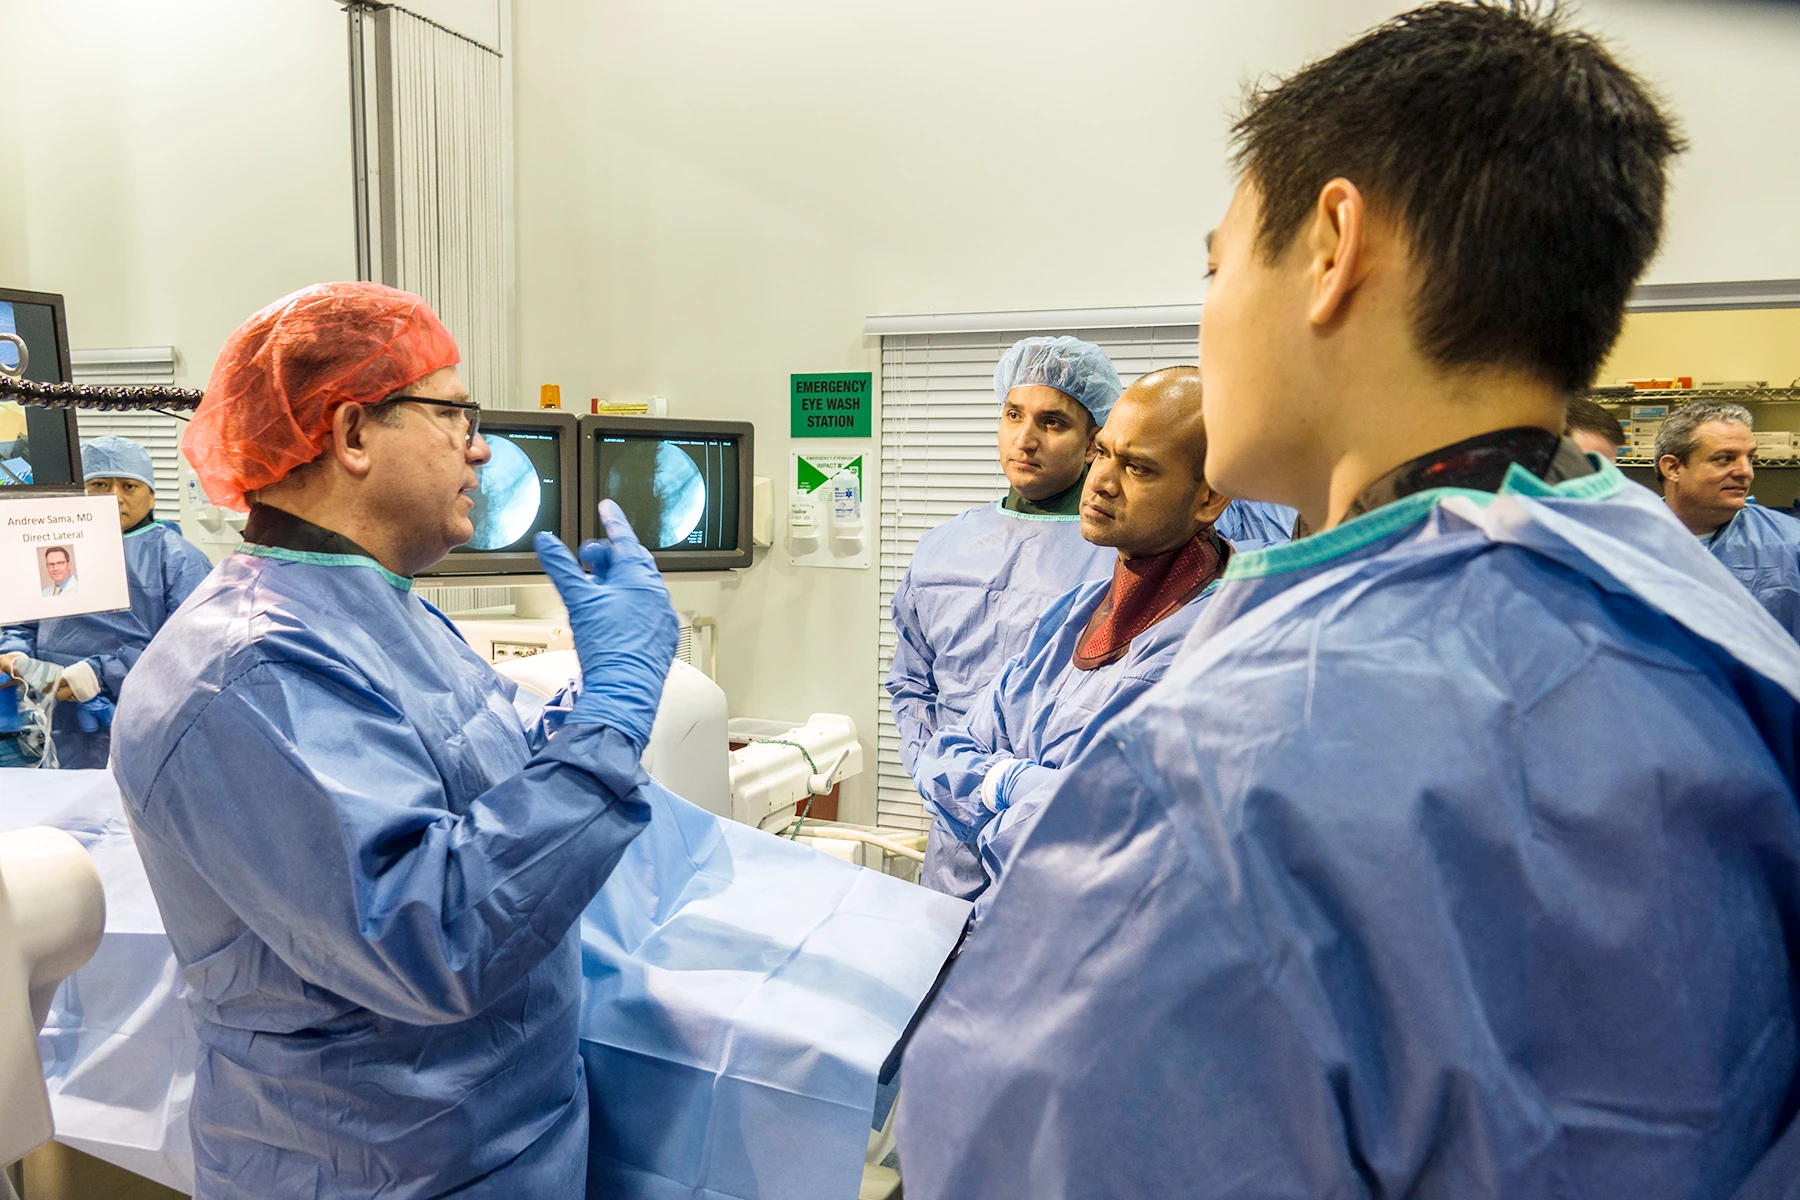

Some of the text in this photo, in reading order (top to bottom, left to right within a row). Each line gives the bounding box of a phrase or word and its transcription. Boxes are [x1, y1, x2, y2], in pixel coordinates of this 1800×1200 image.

[796, 380, 867, 393] EMERGENCY
[802, 397, 860, 410] EYE WASH
[807, 415, 855, 428] STATION
[8, 513, 93, 526] Andrew Sama, MD
[22, 530, 84, 543] Direct Lateral
